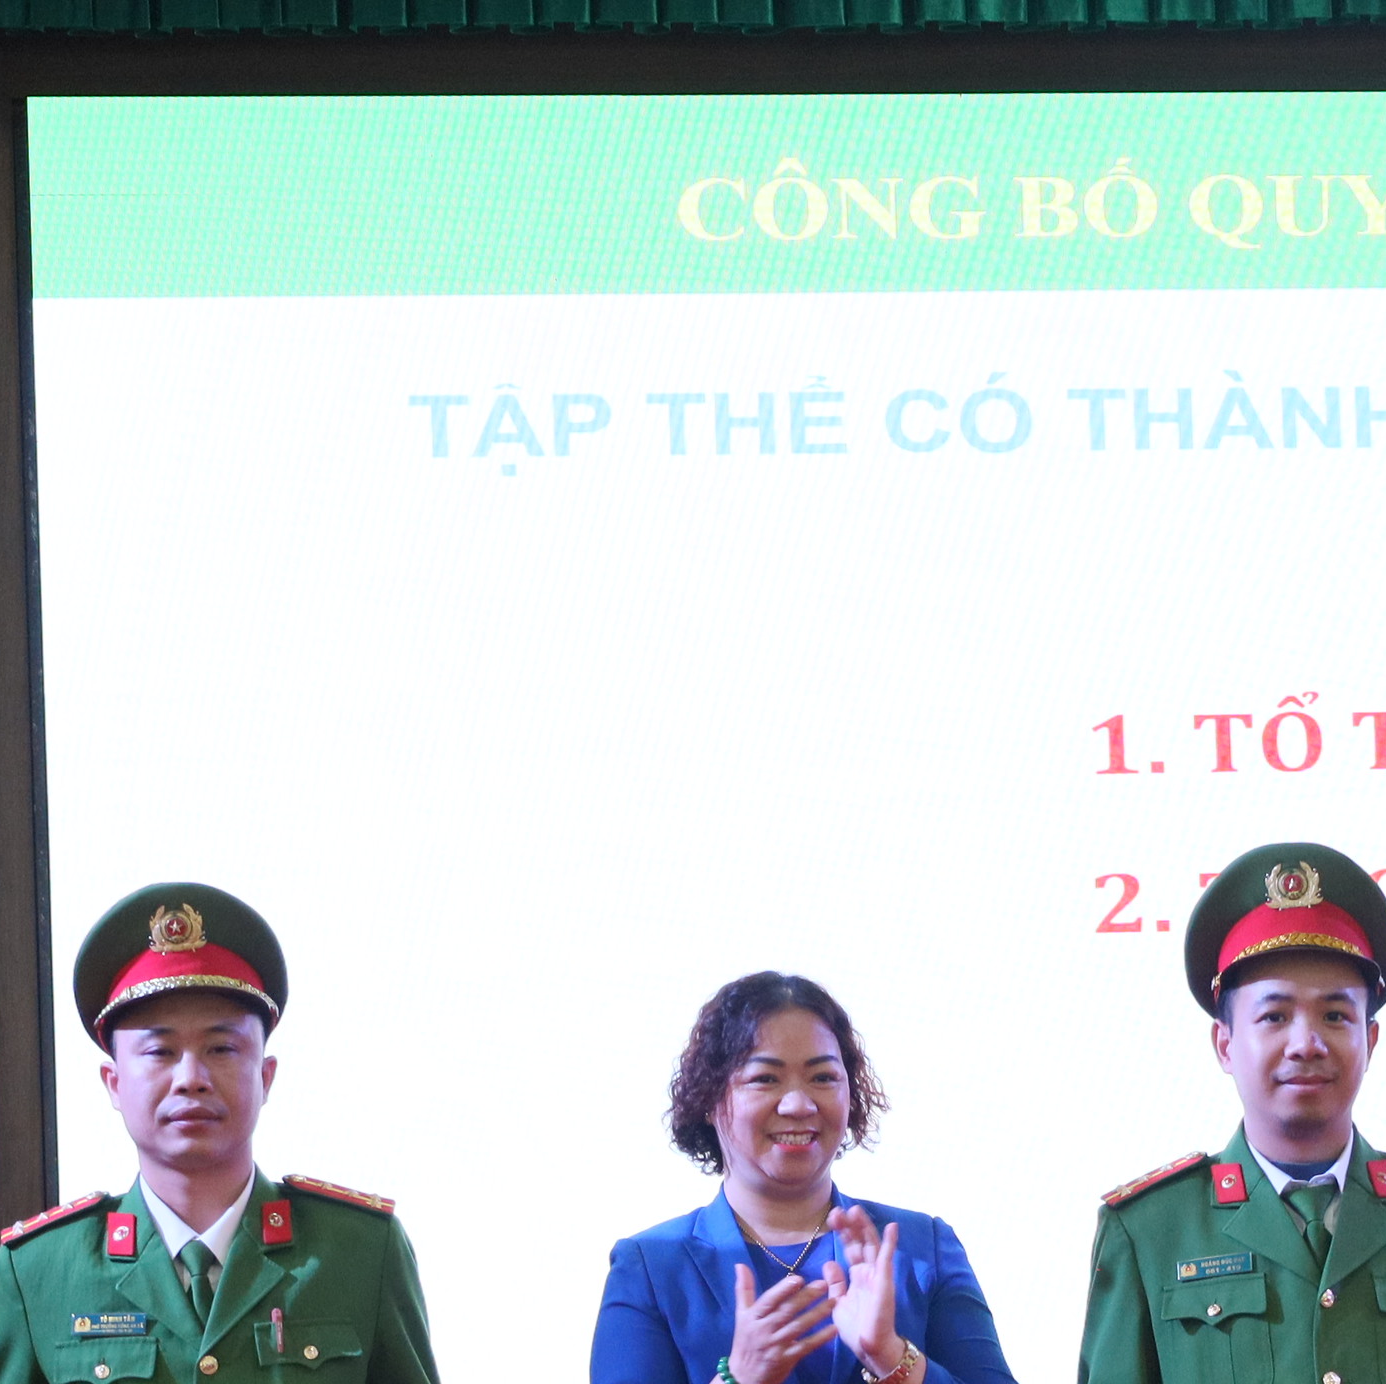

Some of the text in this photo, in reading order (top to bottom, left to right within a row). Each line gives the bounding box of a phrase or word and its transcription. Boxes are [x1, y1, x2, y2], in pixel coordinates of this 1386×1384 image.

[677, 154, 986, 246] CÔNG
[1014, 155, 1159, 240] BỐ
[409, 384, 612, 477] TẬP
[647, 374, 848, 456] THỂ
[884, 372, 1033, 454] CÓ
[1093, 714, 1165, 775] 1.
[1194, 691, 1323, 773] TỔ
[1095, 873, 1170, 933] 2.
